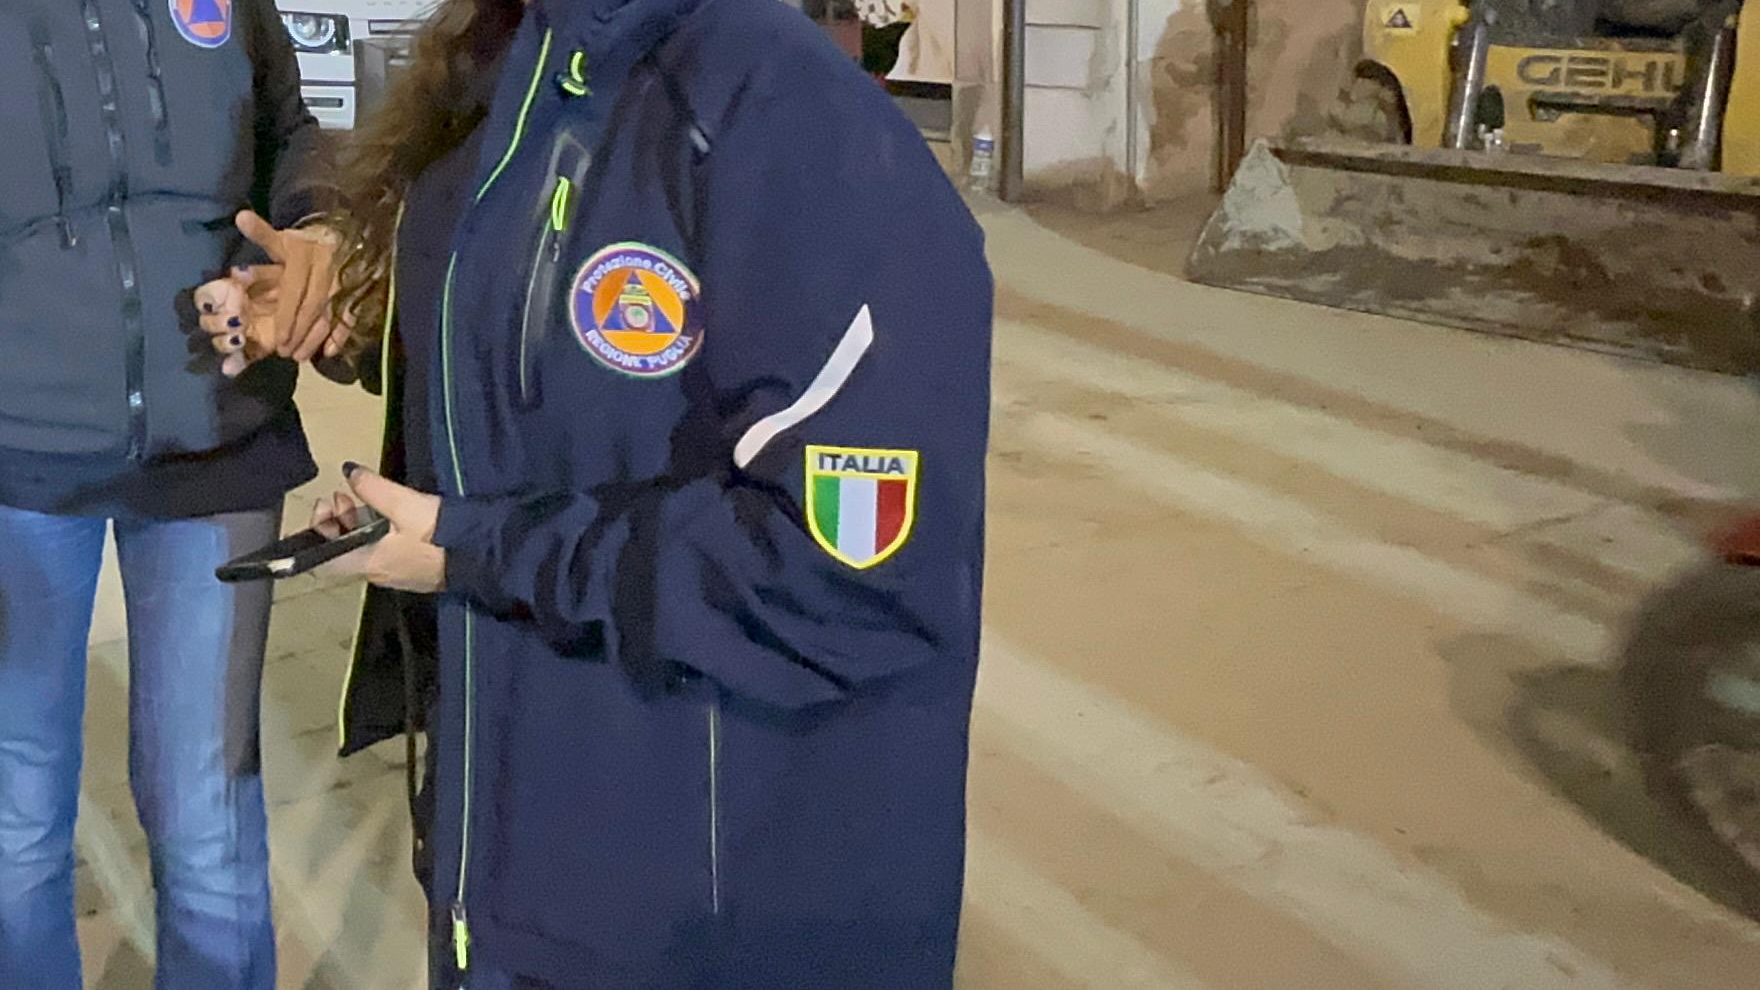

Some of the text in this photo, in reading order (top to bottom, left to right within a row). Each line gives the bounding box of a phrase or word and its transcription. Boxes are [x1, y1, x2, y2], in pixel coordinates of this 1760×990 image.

[582, 255, 652, 293] Protezione
[585, 329, 643, 367] REGIONE
[818, 452, 905, 474] ITALIA
